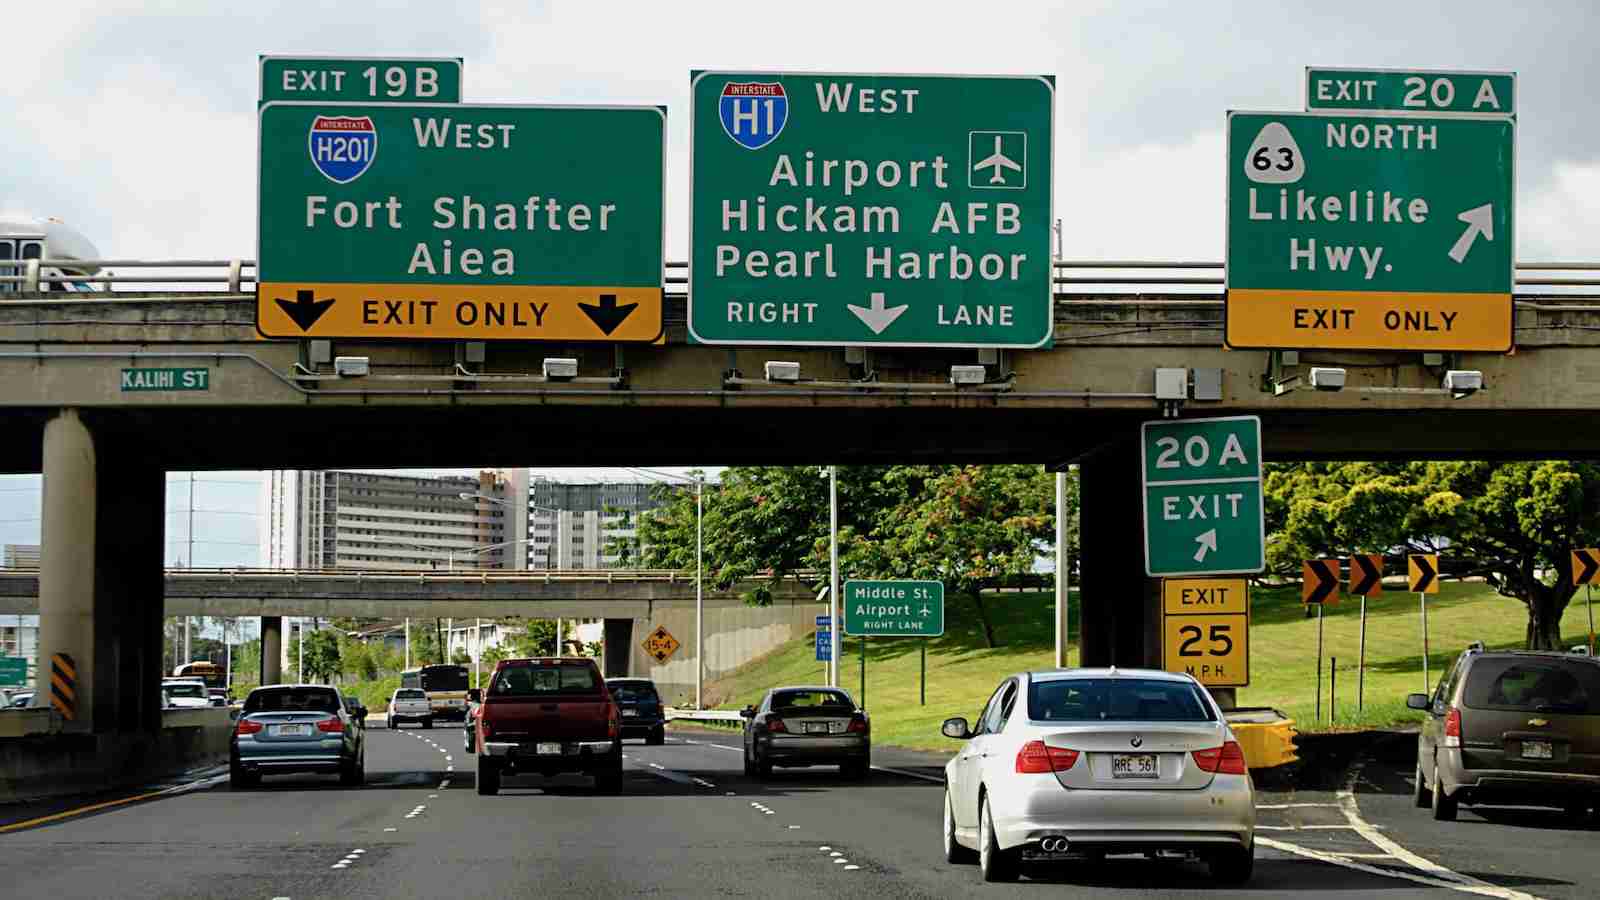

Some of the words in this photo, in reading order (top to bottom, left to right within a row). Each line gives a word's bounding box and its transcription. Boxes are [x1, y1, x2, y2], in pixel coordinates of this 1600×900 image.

[283, 70, 346, 92] EXIT
[363, 66, 439, 97] 19B
[731, 85, 777, 95] INTERSTATE
[1317, 79, 1377, 101] EXIT
[1403, 77, 1455, 107] 20
[1473, 79, 1500, 109] A
[815, 82, 920, 114] WEST
[319, 119, 366, 129] INTERSTATE
[733, 98, 774, 135] H1
[412, 117, 516, 149] WEST
[1326, 123, 1437, 150] NORTH
[318, 137, 369, 162] H201
[1252, 147, 1295, 171] 63
[769, 151, 949, 195] Airport
[306, 195, 402, 229] Fort
[433, 195, 616, 231] Shafter
[722, 196, 900, 233] Hickam
[931, 202, 1021, 235] AFB
[1249, 187, 1429, 223] Likelike
[407, 239, 515, 276] Aiea
[716, 244, 837, 278] Pearl
[866, 246, 1027, 281] Harbor
[1290, 238, 1393, 280] Hwy.
[362, 300, 438, 325] EXIT
[456, 301, 549, 327] ONLY
[727, 302, 818, 323] RIGHT
[937, 305, 1014, 326] LANE
[1294, 308, 1355, 330] EXIT
[1384, 310, 1458, 331] ONLY
[121, 371, 174, 387] KALIHI
[183, 370, 207, 387] ST
[1163, 493, 1243, 521] EXIT
[855, 587, 905, 599] Middle
[913, 588, 933, 599] St.
[1181, 588, 1229, 605] EXIT
[855, 604, 910, 617] Airport
[864, 621, 893, 629] RIGHT
[898, 621, 924, 629] LANE
[1178, 625, 1233, 657] 25
